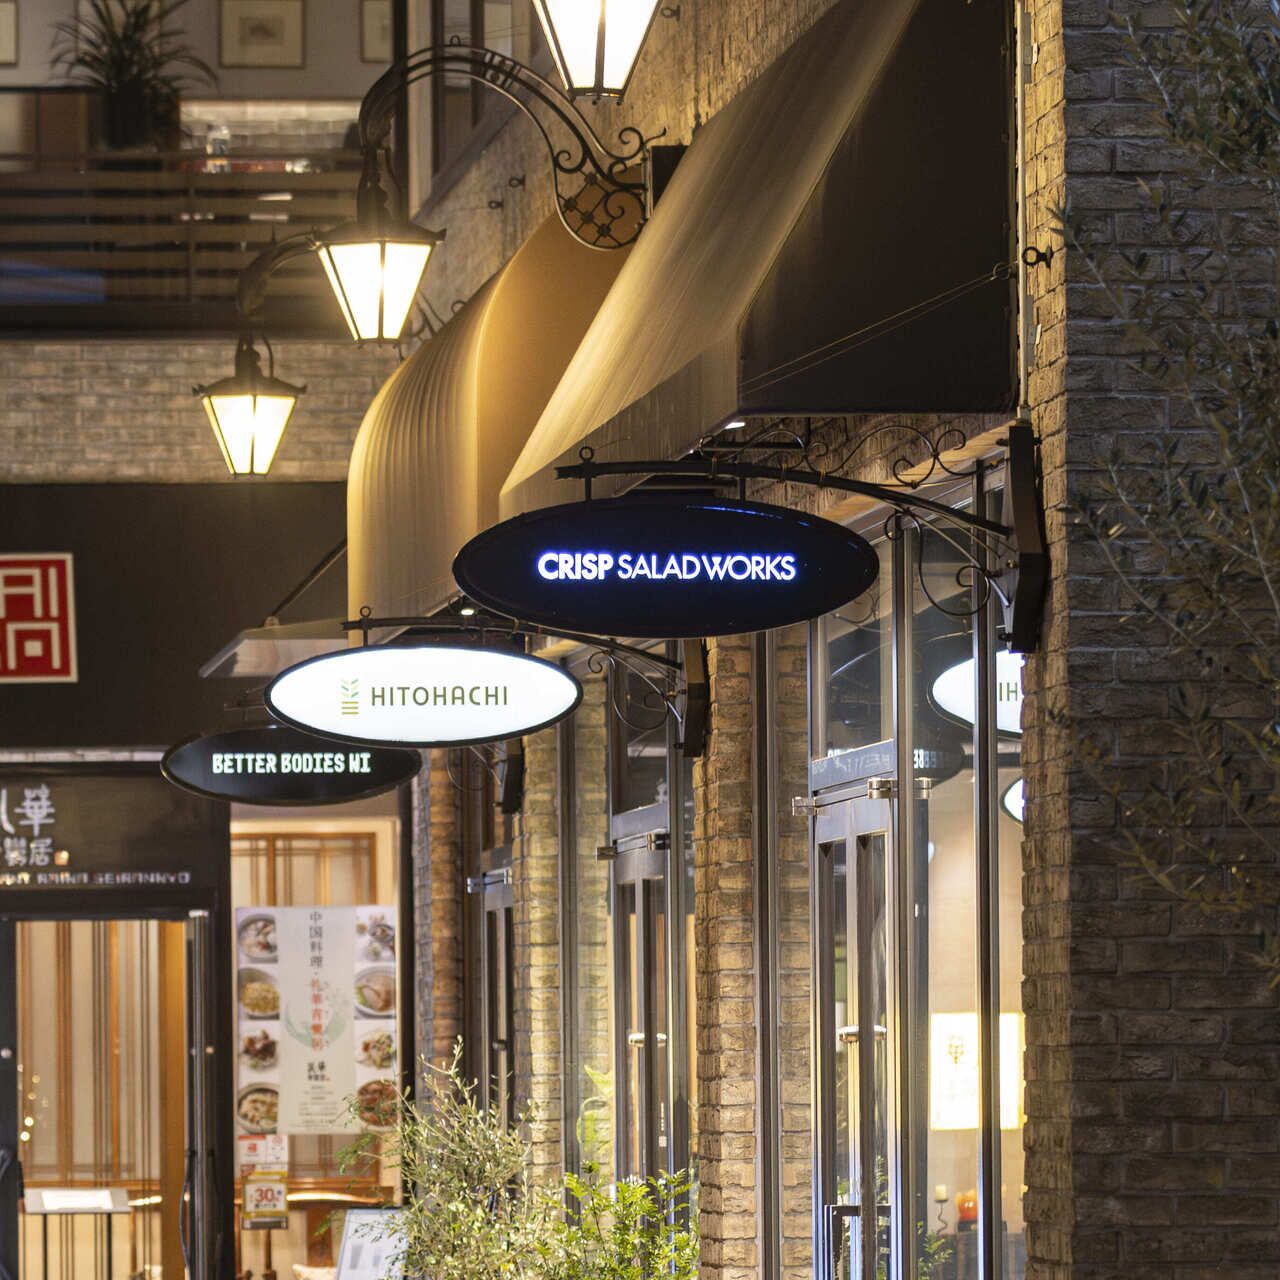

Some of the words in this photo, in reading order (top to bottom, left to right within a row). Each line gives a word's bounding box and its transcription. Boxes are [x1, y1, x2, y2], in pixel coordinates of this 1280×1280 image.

[537, 553, 614, 580] CRISP
[371, 686, 508, 706] HITOHACHI
[212, 753, 277, 774] BETTER
[281, 753, 345, 773] BODIES
